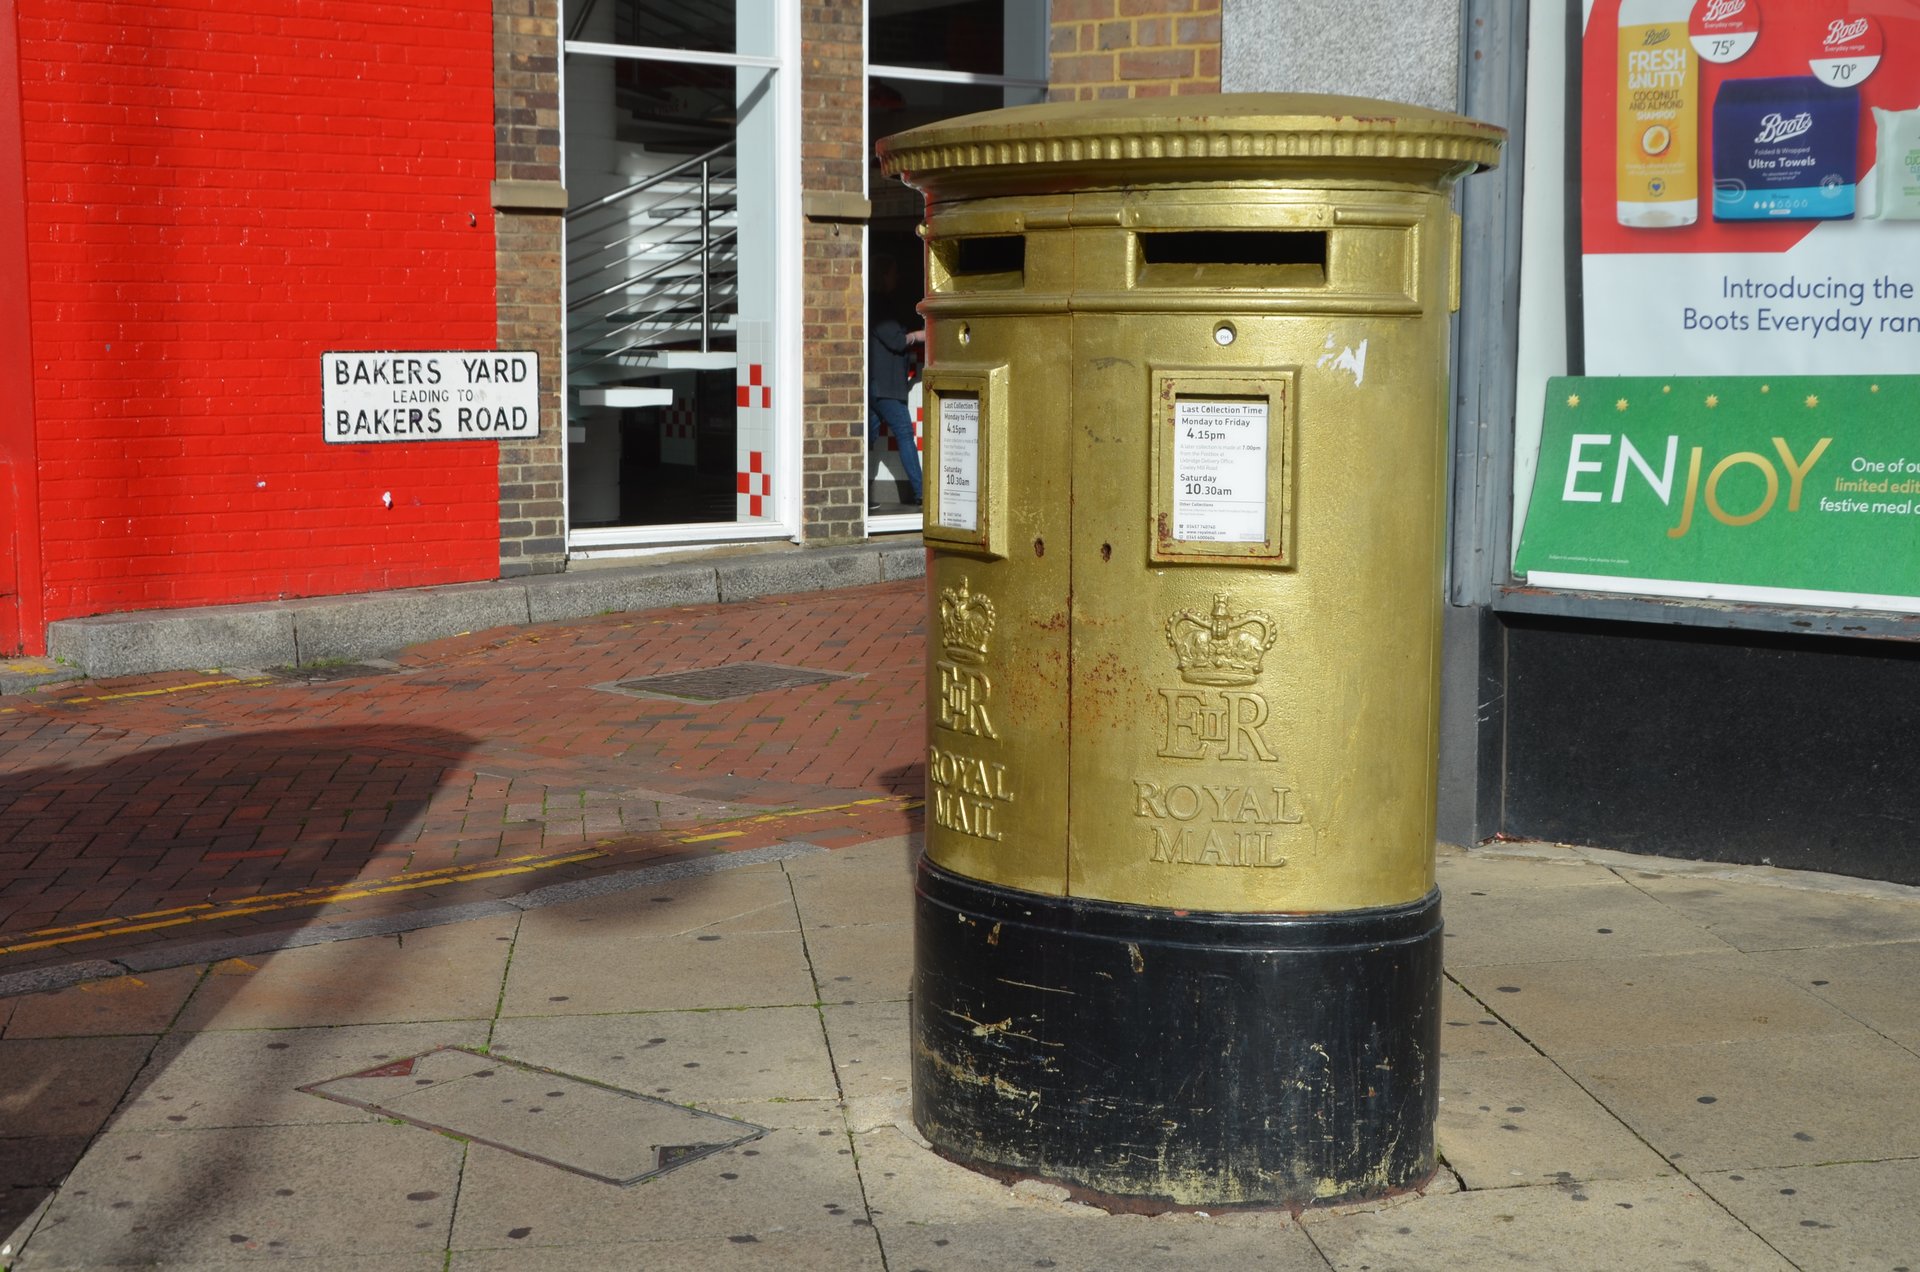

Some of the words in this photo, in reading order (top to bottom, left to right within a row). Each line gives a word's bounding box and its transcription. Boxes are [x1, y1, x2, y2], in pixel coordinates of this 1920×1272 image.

[1823, 17, 1869, 45] Boots
[1628, 48, 1686, 73] FRESH
[1633, 89, 1679, 101] COCONUT
[1629, 100, 1646, 111] AND
[1647, 98, 1683, 110] ALMOND
[1636, 110, 1676, 121] SHAMPOO
[1754, 111, 1813, 144] Boots
[1754, 148, 1775, 156] Folded
[1782, 146, 1811, 156] Wrapped
[1748, 158, 1776, 170] Ultra
[1778, 156, 1816, 167] Towels
[1723, 275, 1865, 306] Introducing
[1873, 275, 1914, 300] the
[1684, 307, 1750, 332] Boots
[1757, 308, 1873, 339] Everyday
[1880, 315, 1920, 333] ran
[335, 359, 442, 385] BAKERS
[462, 358, 527, 384] YARD
[393, 389, 449, 403] LEADING
[457, 389, 473, 402] TO
[944, 413, 960, 421] Monday
[1182, 405, 1199, 413] Last
[1201, 405, 1241, 414] Collection
[1242, 406, 1263, 414] Time
[337, 407, 442, 436] BAKERS
[458, 406, 528, 432] ROAD
[947, 422, 967, 435] 4.15pm
[1181, 418, 1212, 427] Monday
[1225, 418, 1250, 427] Friday
[1187, 427, 1226, 441] 4.15pm
[944, 465, 962, 474] Saturday
[1851, 457, 1886, 473] One
[1887, 457, 1905, 473] of
[946, 474, 970, 486] 10.30am
[1180, 474, 1217, 483] Saturday
[1562, 432, 1833, 539] ENJOY
[1834, 476, 1889, 493] limited
[1185, 483, 1232, 496] 10.30am
[1819, 496, 1869, 513] festive
[1872, 499, 1912, 514] meal
[930, 745, 1015, 802] ROYAL
[1133, 779, 1303, 825] ROYAL
[934, 787, 1003, 842] MAIL
[1150, 825, 1287, 868] MAIL
